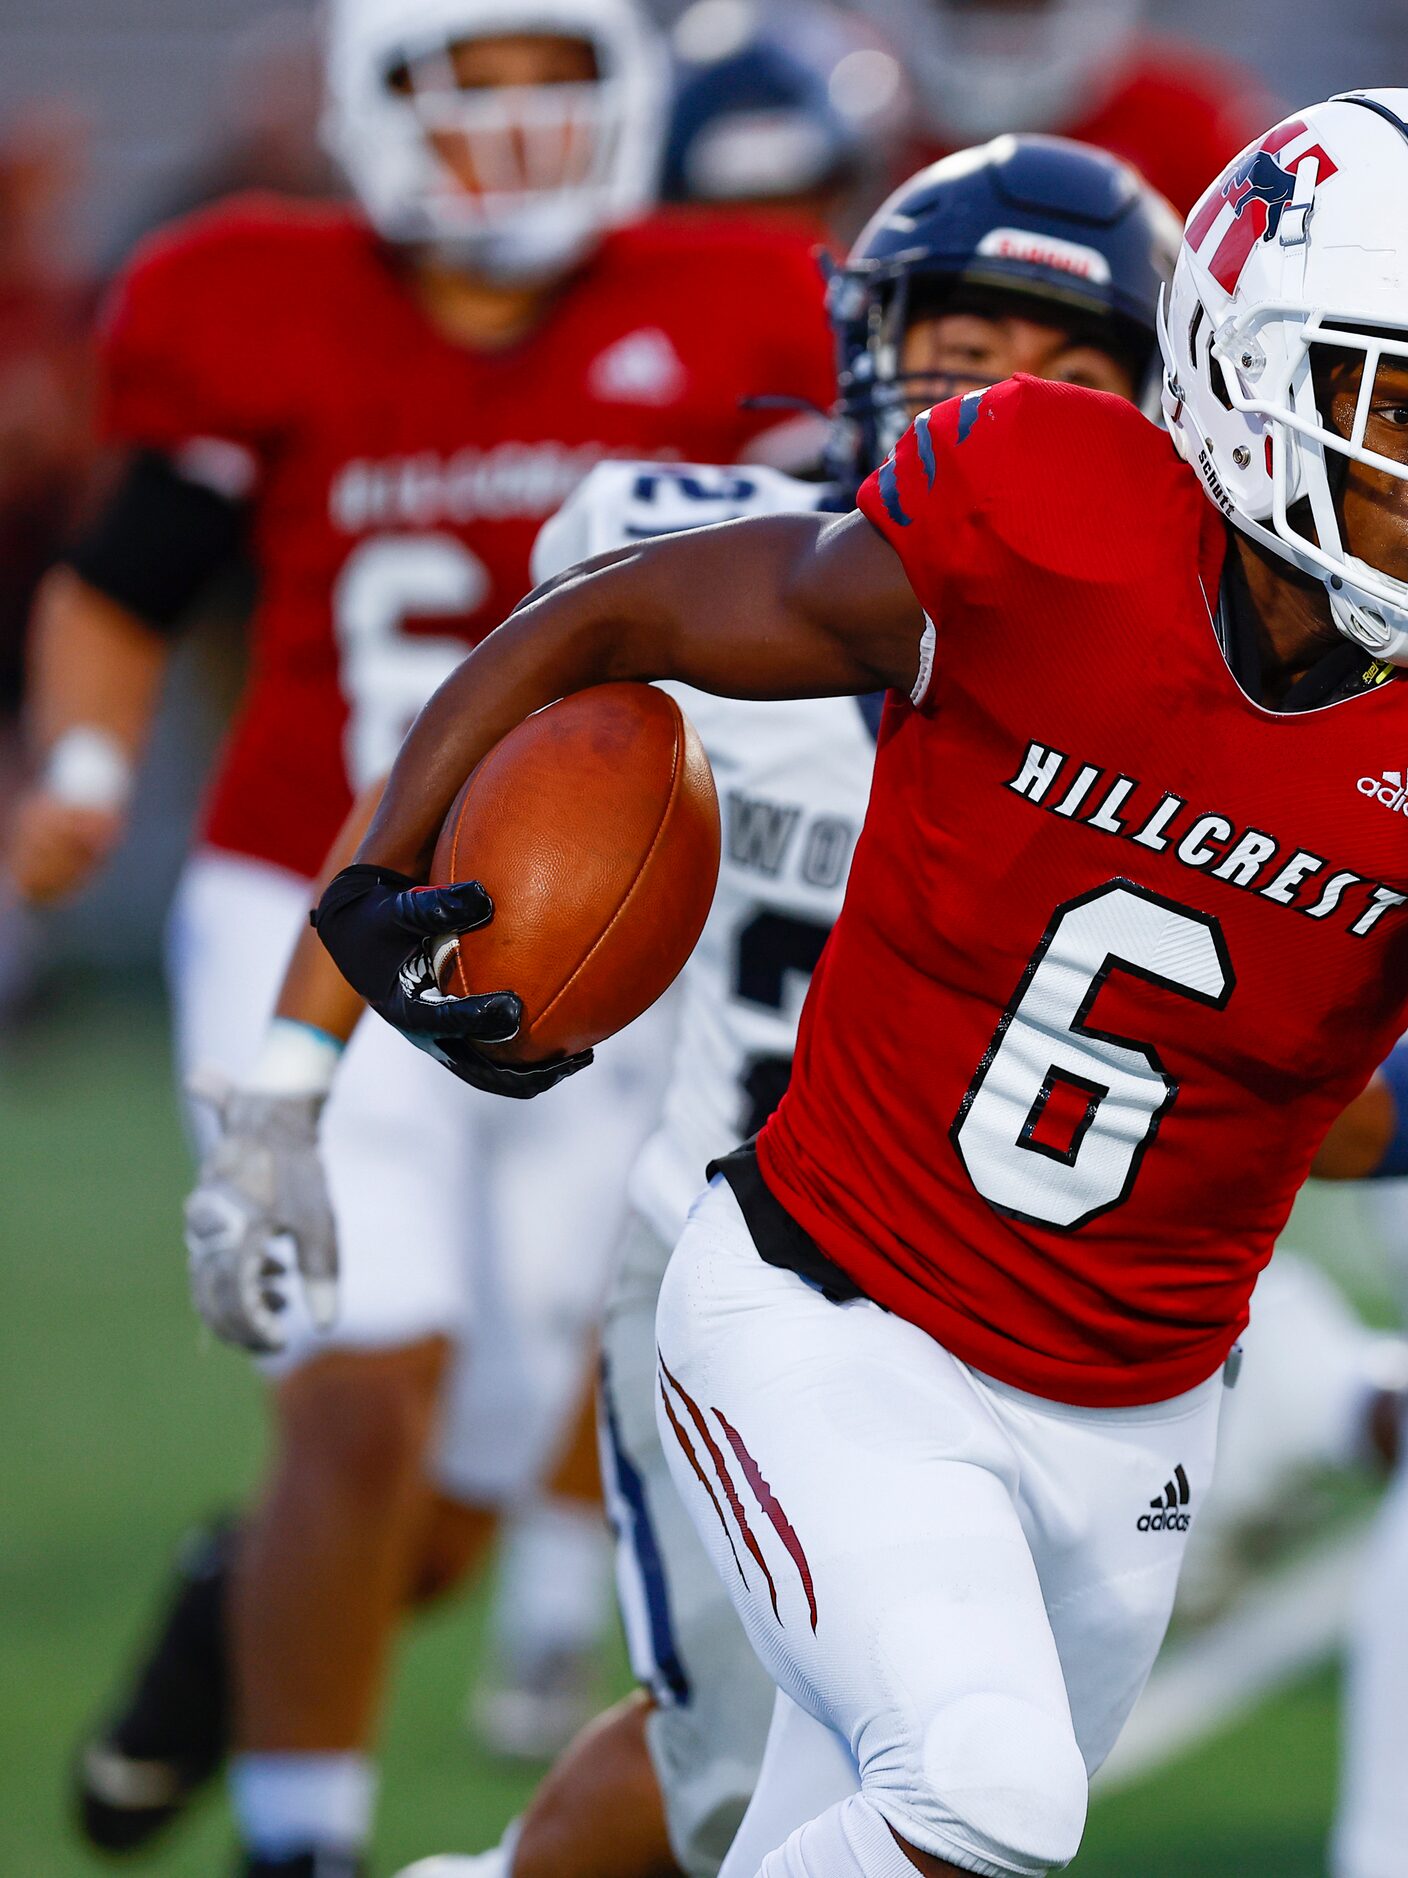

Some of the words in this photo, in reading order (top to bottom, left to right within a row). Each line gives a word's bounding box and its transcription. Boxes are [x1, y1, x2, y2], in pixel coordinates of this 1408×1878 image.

[1198, 449, 1235, 517] schutt
[1002, 738, 1408, 938] HILLCREST
[948, 874, 1238, 1233] 6
[1136, 1505, 1191, 1532] adidas
